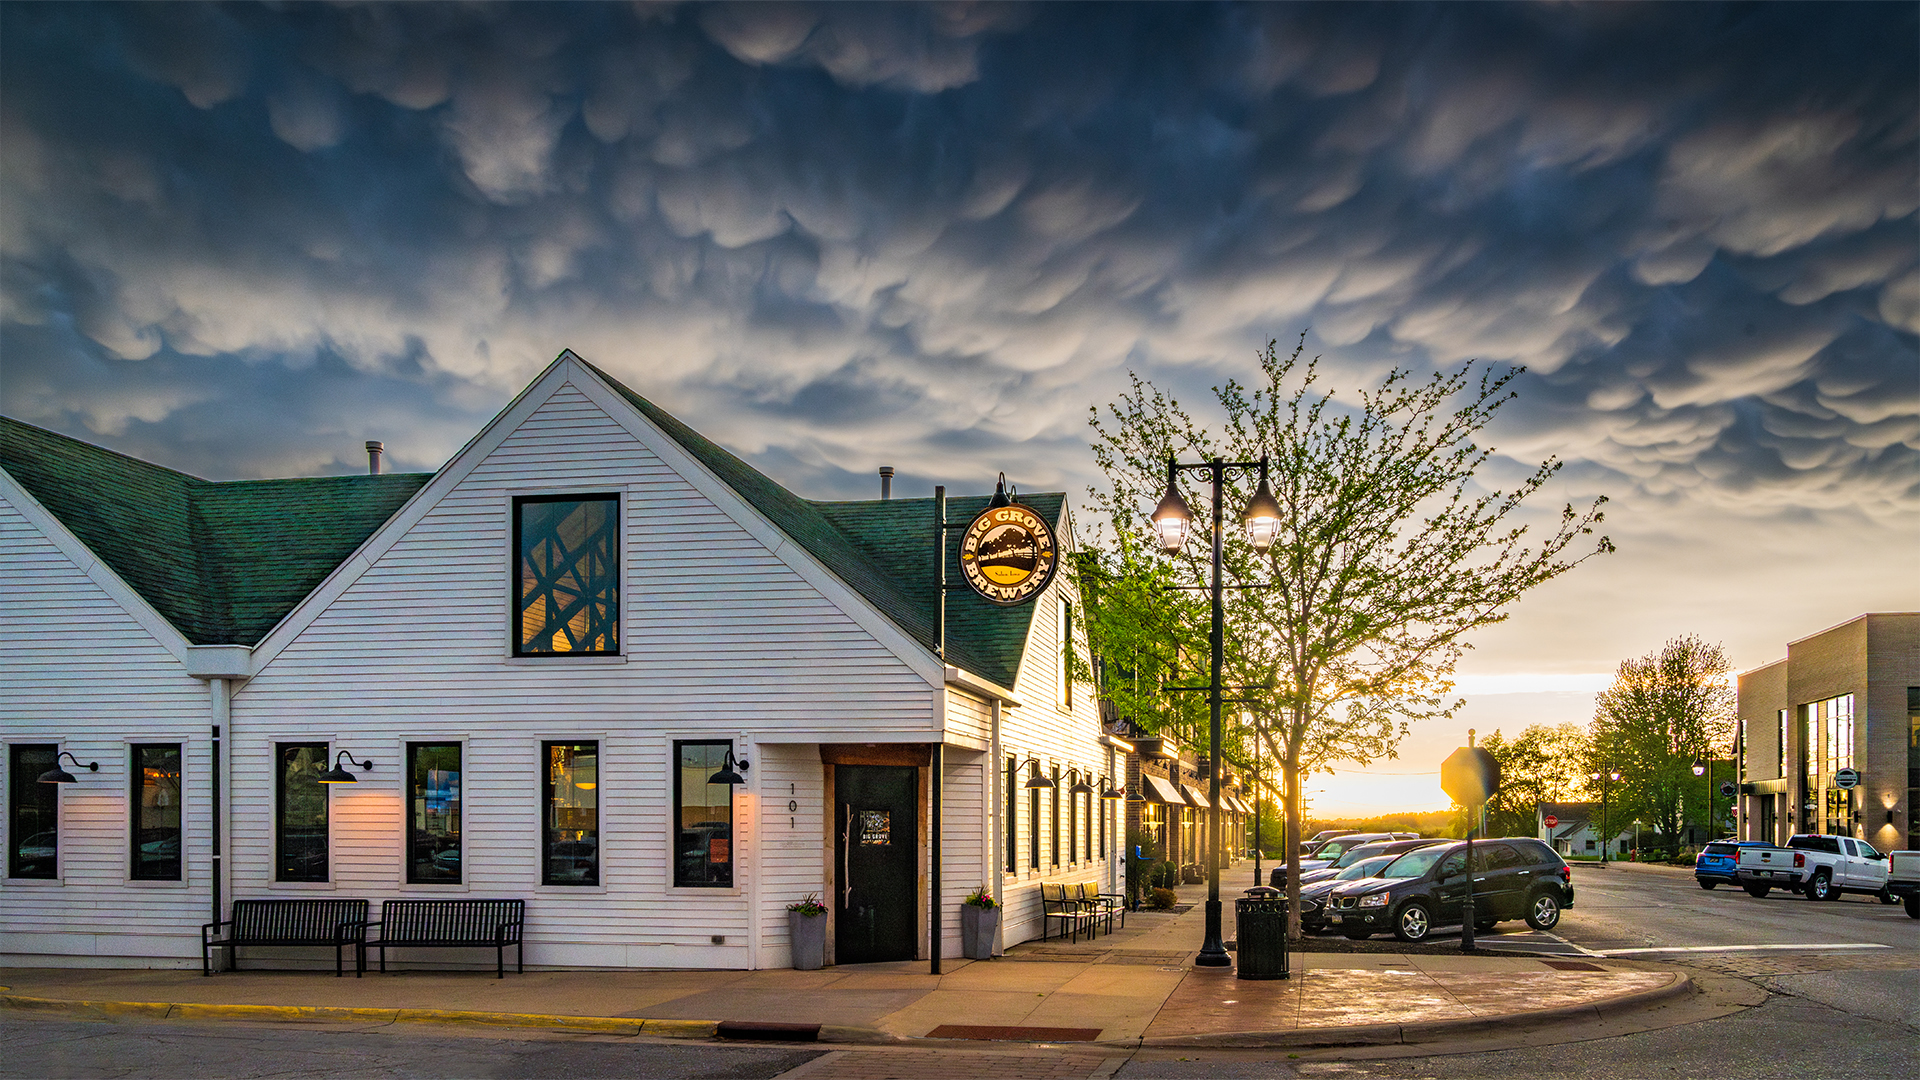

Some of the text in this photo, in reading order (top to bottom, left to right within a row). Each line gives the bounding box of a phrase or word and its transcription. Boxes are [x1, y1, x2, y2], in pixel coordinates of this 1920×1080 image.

[965, 510, 1051, 553] BIG GROVE
[965, 559, 1050, 599] BREWERY
[788, 783, 798, 829] 101
